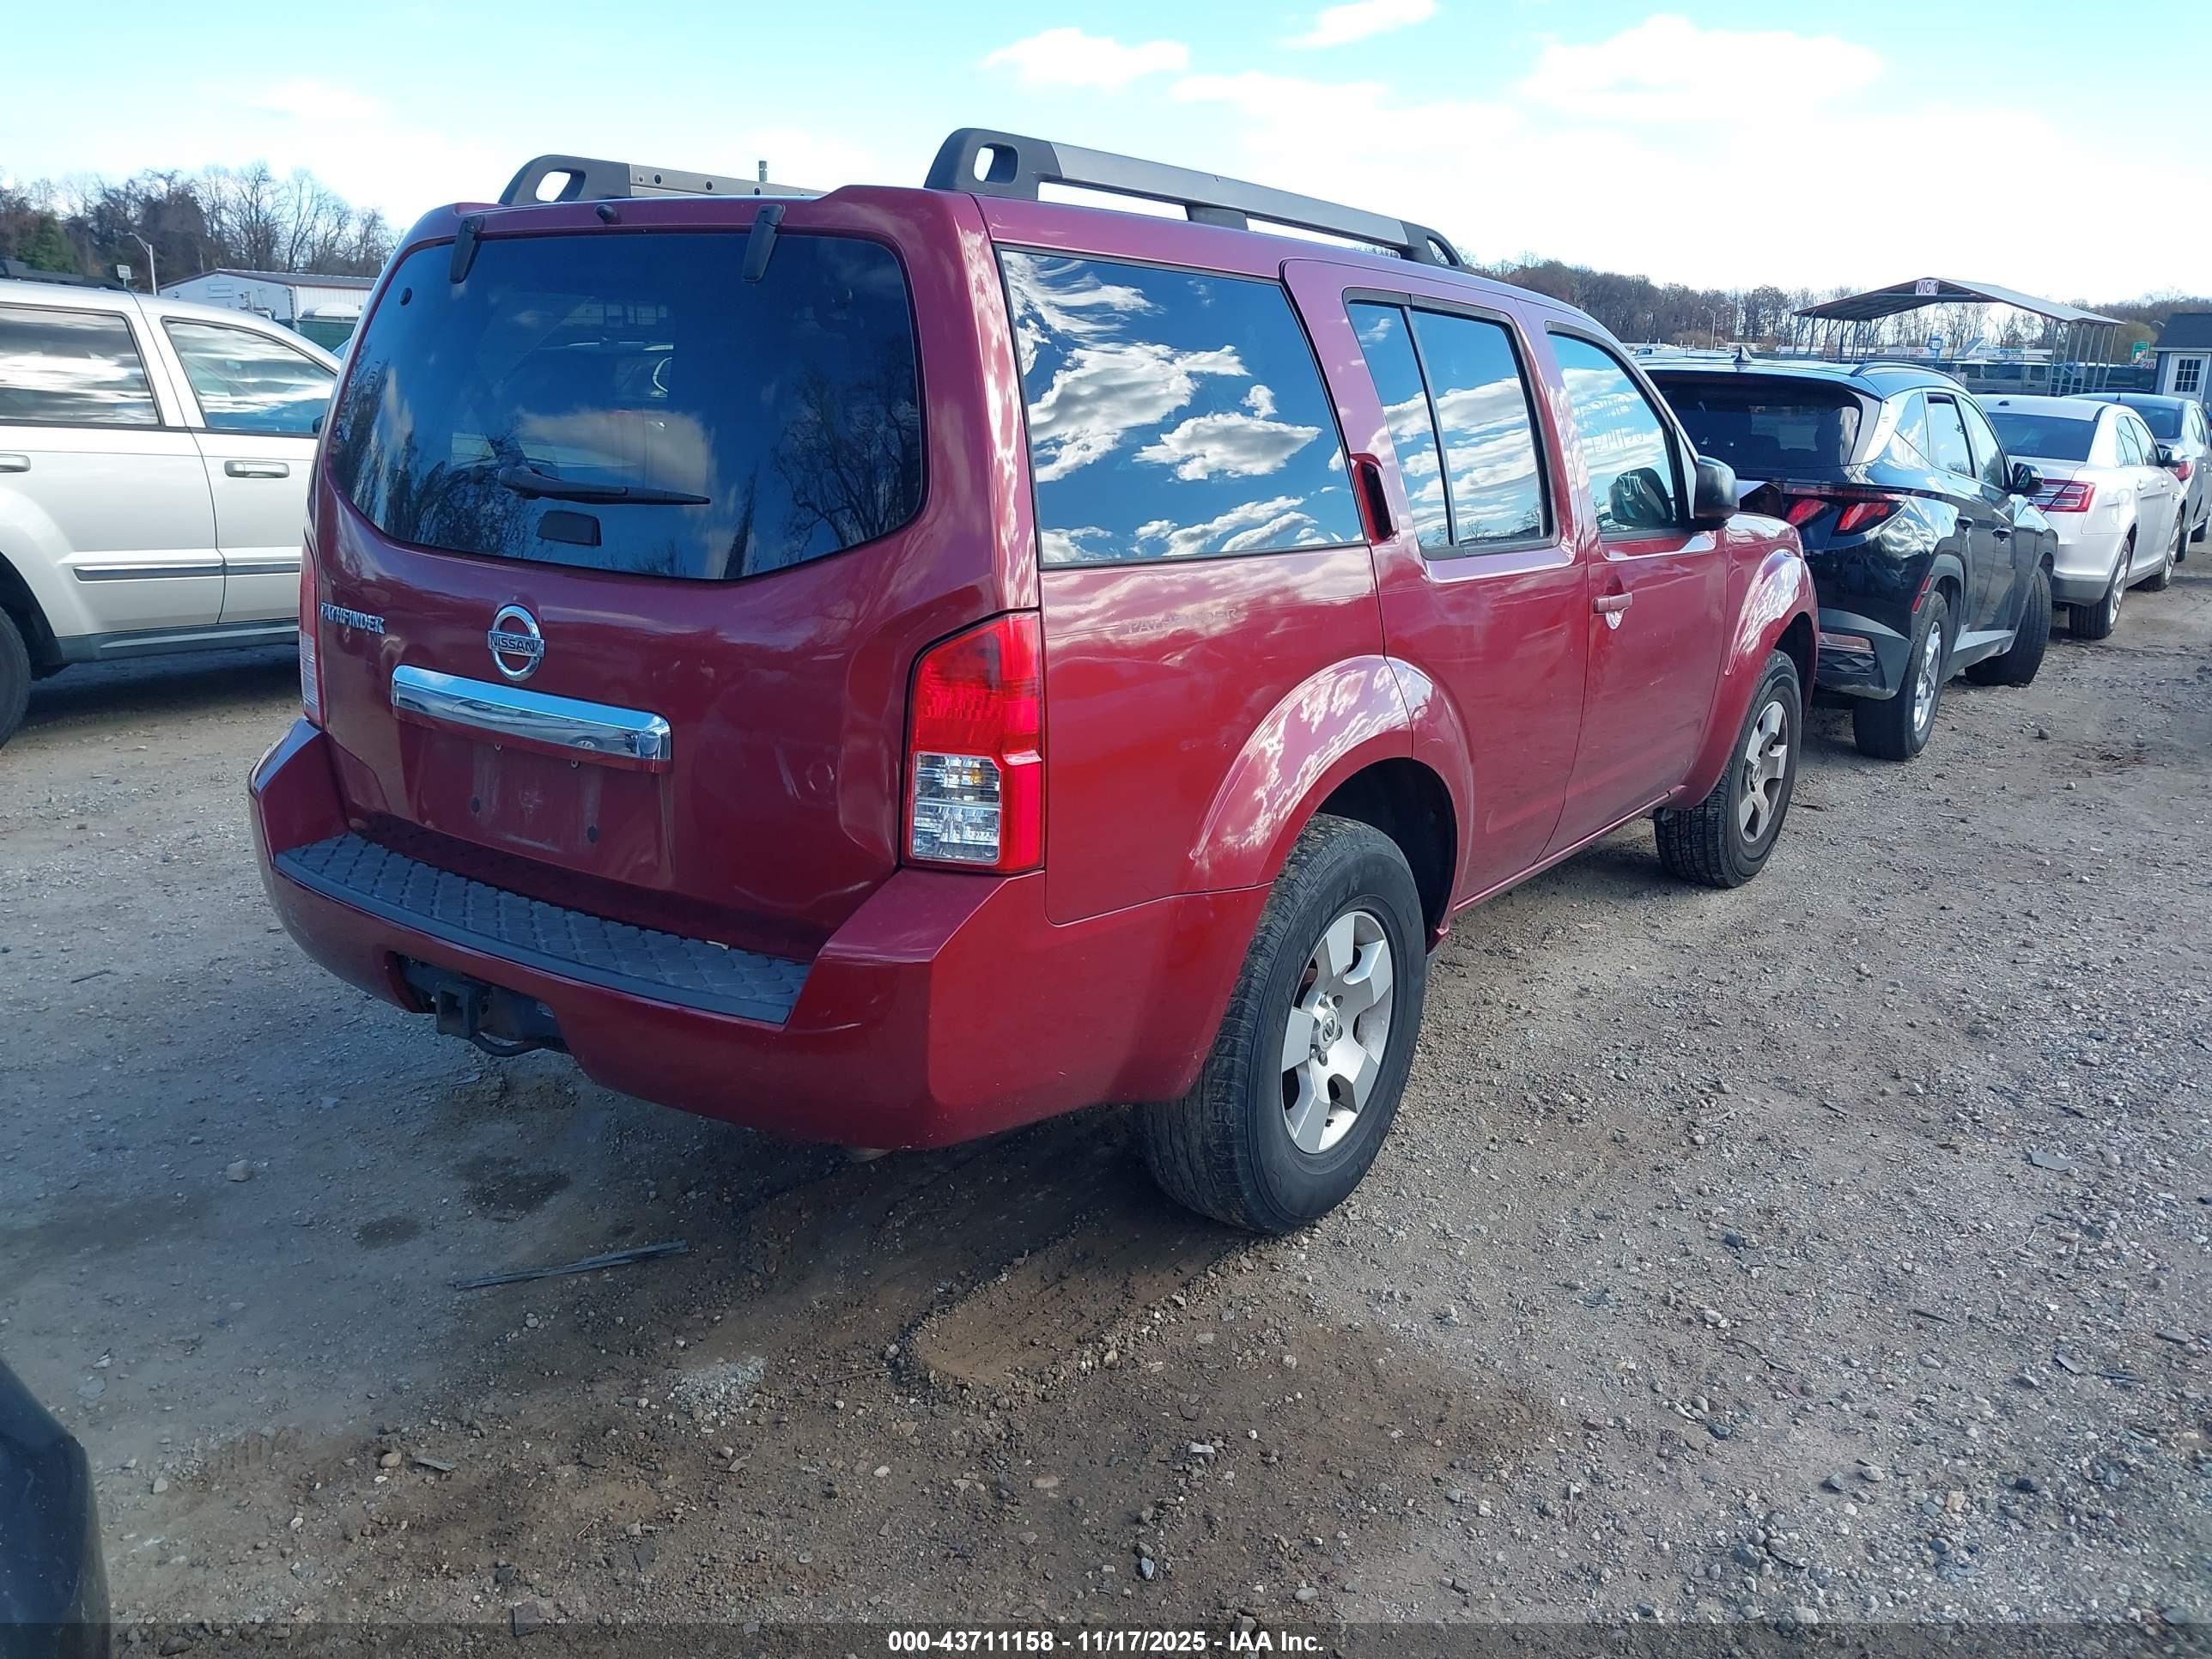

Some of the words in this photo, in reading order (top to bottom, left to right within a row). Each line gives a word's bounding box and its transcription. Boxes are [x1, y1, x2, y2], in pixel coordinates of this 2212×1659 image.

[1917, 281, 1931, 294] VIC
[1933, 281, 1938, 294] 1
[319, 602, 386, 635] PATHFINDER
[489, 635, 535, 653] NISSAN
